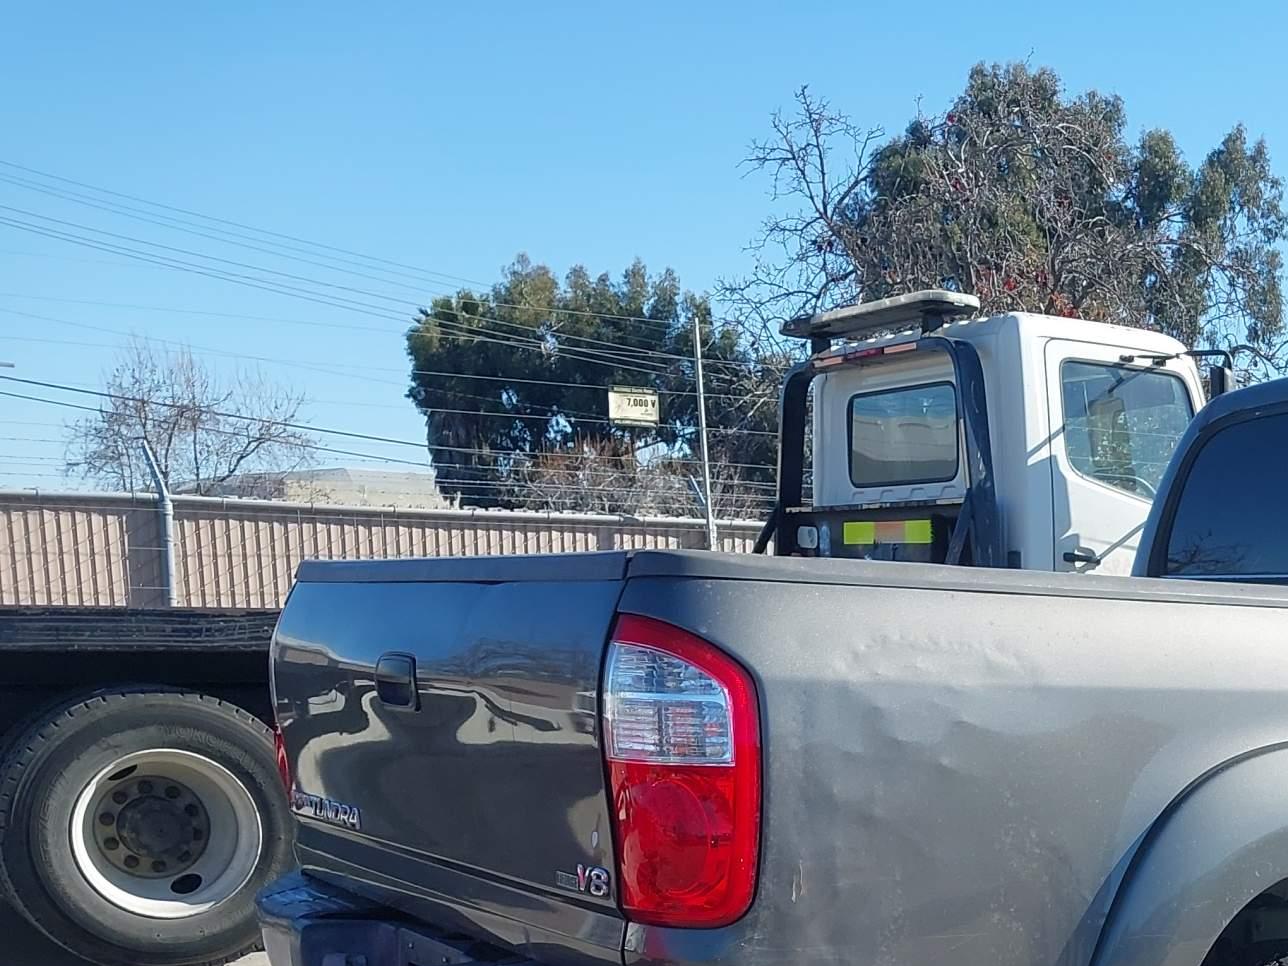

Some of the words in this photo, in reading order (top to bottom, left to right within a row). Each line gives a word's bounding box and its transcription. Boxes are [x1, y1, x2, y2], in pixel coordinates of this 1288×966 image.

[624, 397, 649, 408] 7,000
[308, 796, 361, 830] TUNDRA
[577, 863, 609, 896] V8
